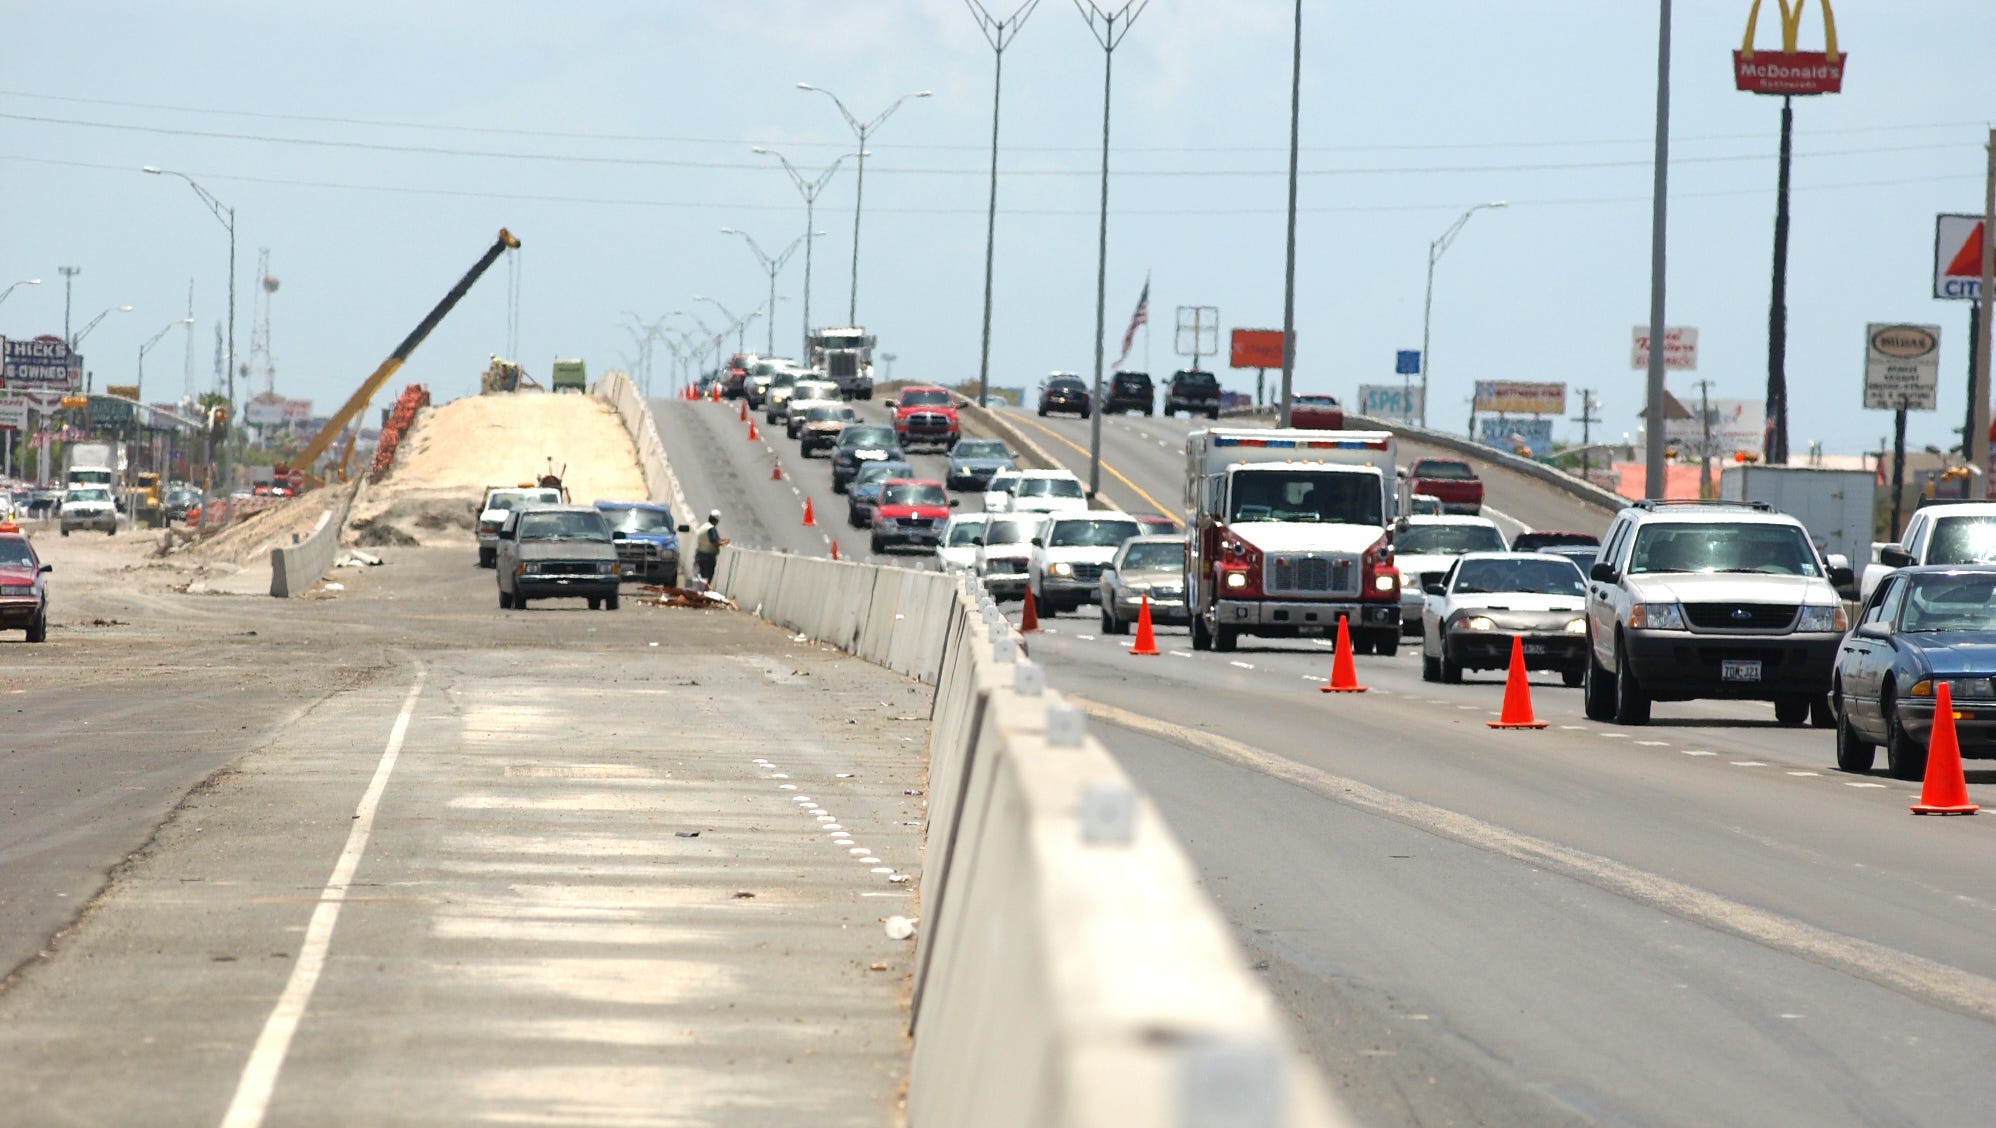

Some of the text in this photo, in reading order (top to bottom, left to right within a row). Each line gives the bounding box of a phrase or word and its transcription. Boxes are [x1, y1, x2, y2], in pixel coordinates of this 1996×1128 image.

[1741, 63, 1840, 79] McDonald's
[1945, 279, 1996, 297] CIT
[1368, 389, 1414, 413] SPAS
